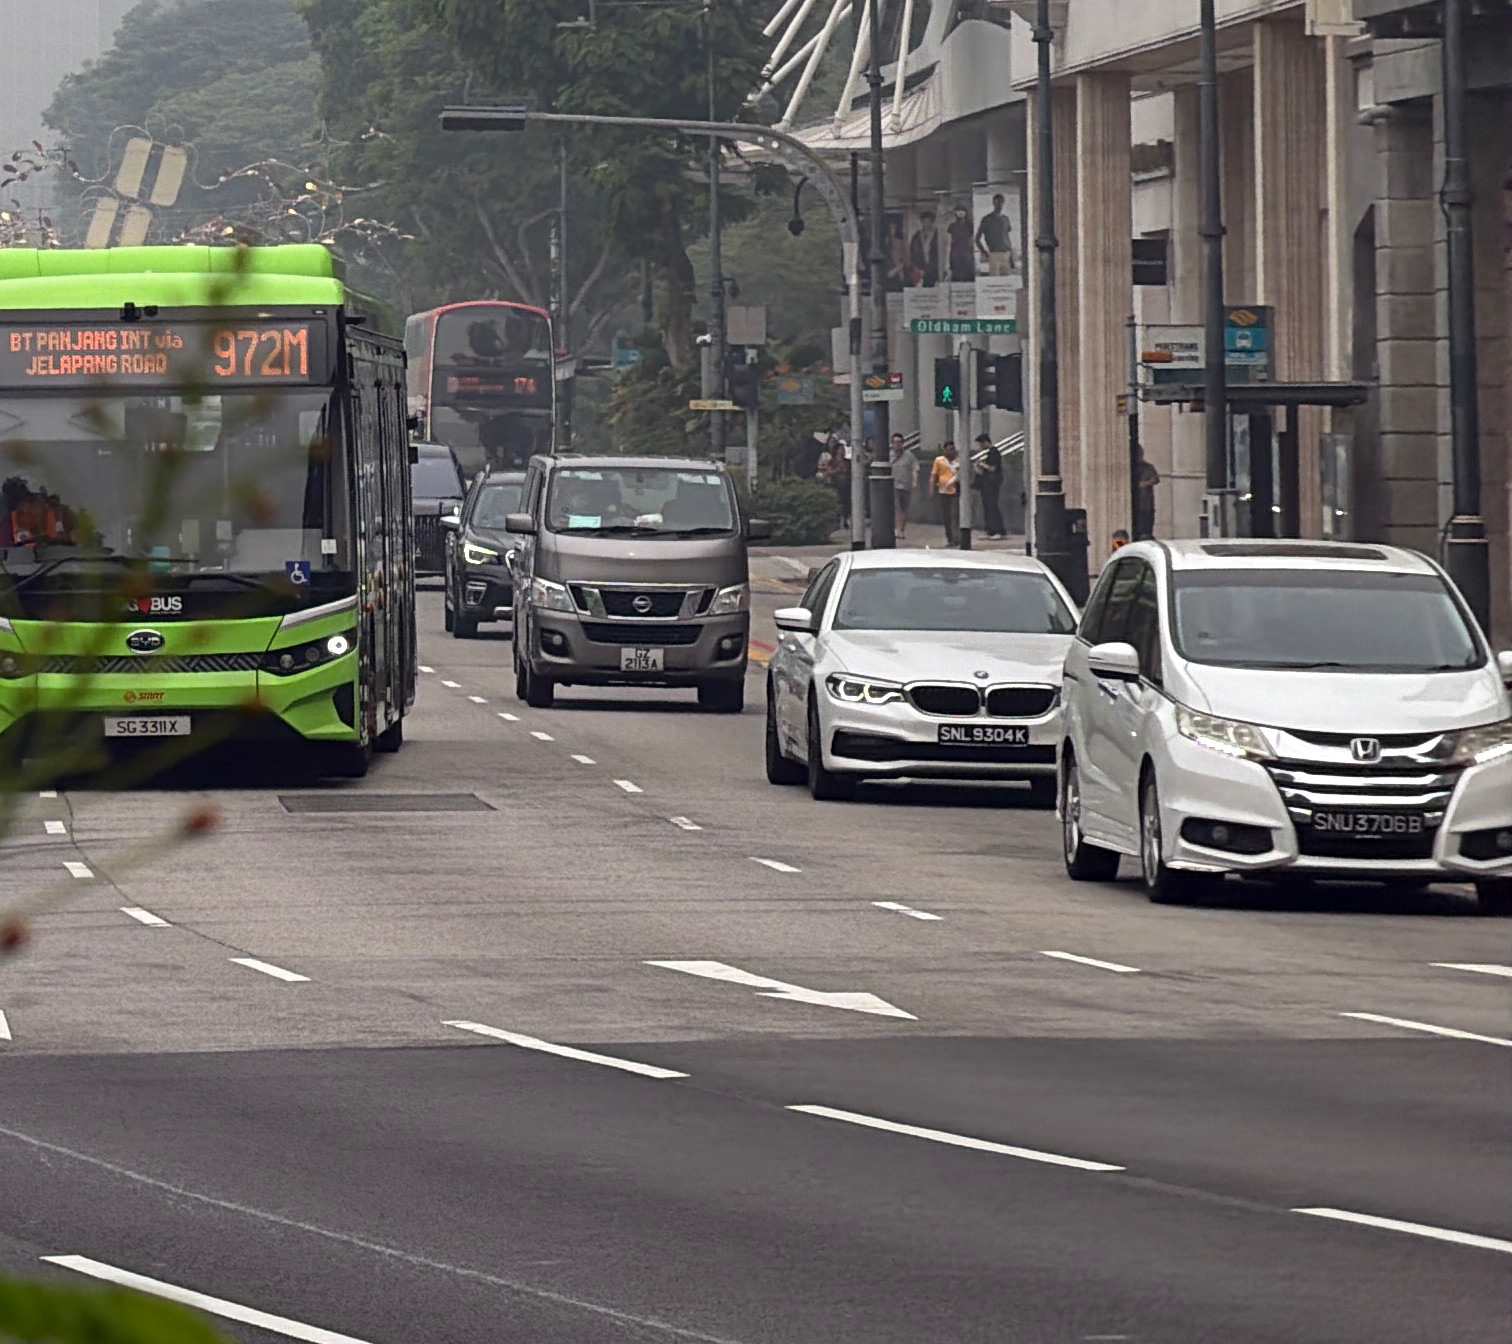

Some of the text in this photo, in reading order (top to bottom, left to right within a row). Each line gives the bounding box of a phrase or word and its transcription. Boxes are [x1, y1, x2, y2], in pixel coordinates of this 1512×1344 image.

[918, 320, 1011, 332] Oldham Lane
[10, 329, 184, 352] BT PANJANG INT via
[214, 328, 308, 376] 972M
[26, 353, 168, 375] JELAPANG ROAD
[151, 596, 183, 611] BUS
